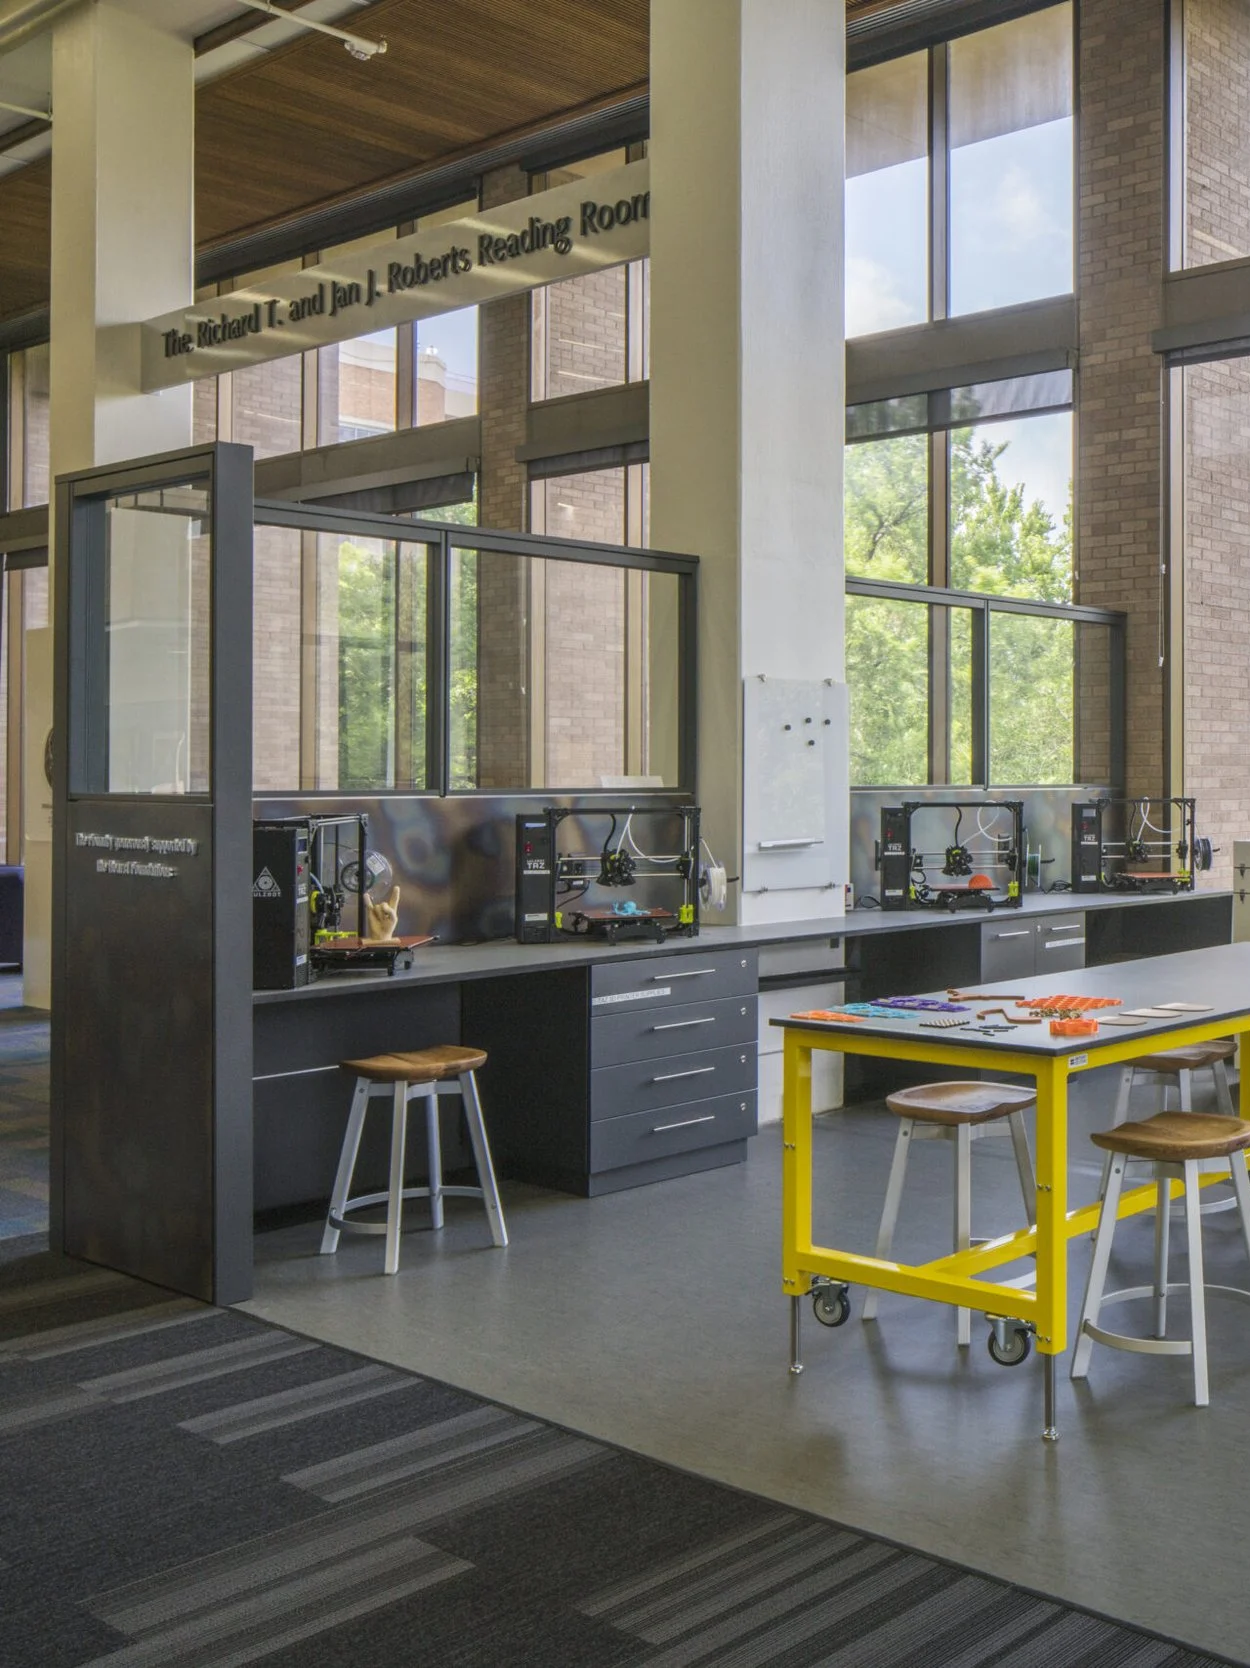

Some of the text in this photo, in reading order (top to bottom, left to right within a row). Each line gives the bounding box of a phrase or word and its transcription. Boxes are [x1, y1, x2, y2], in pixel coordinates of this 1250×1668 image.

[161, 328, 194, 358] The
[197, 303, 262, 348] Richard
[264, 299, 284, 328] T.
[289, 283, 325, 322] and
[328, 280, 361, 317] Jan
[365, 269, 382, 308] J.
[387, 245, 473, 294] Roberts
[477, 215, 573, 267] Reading
